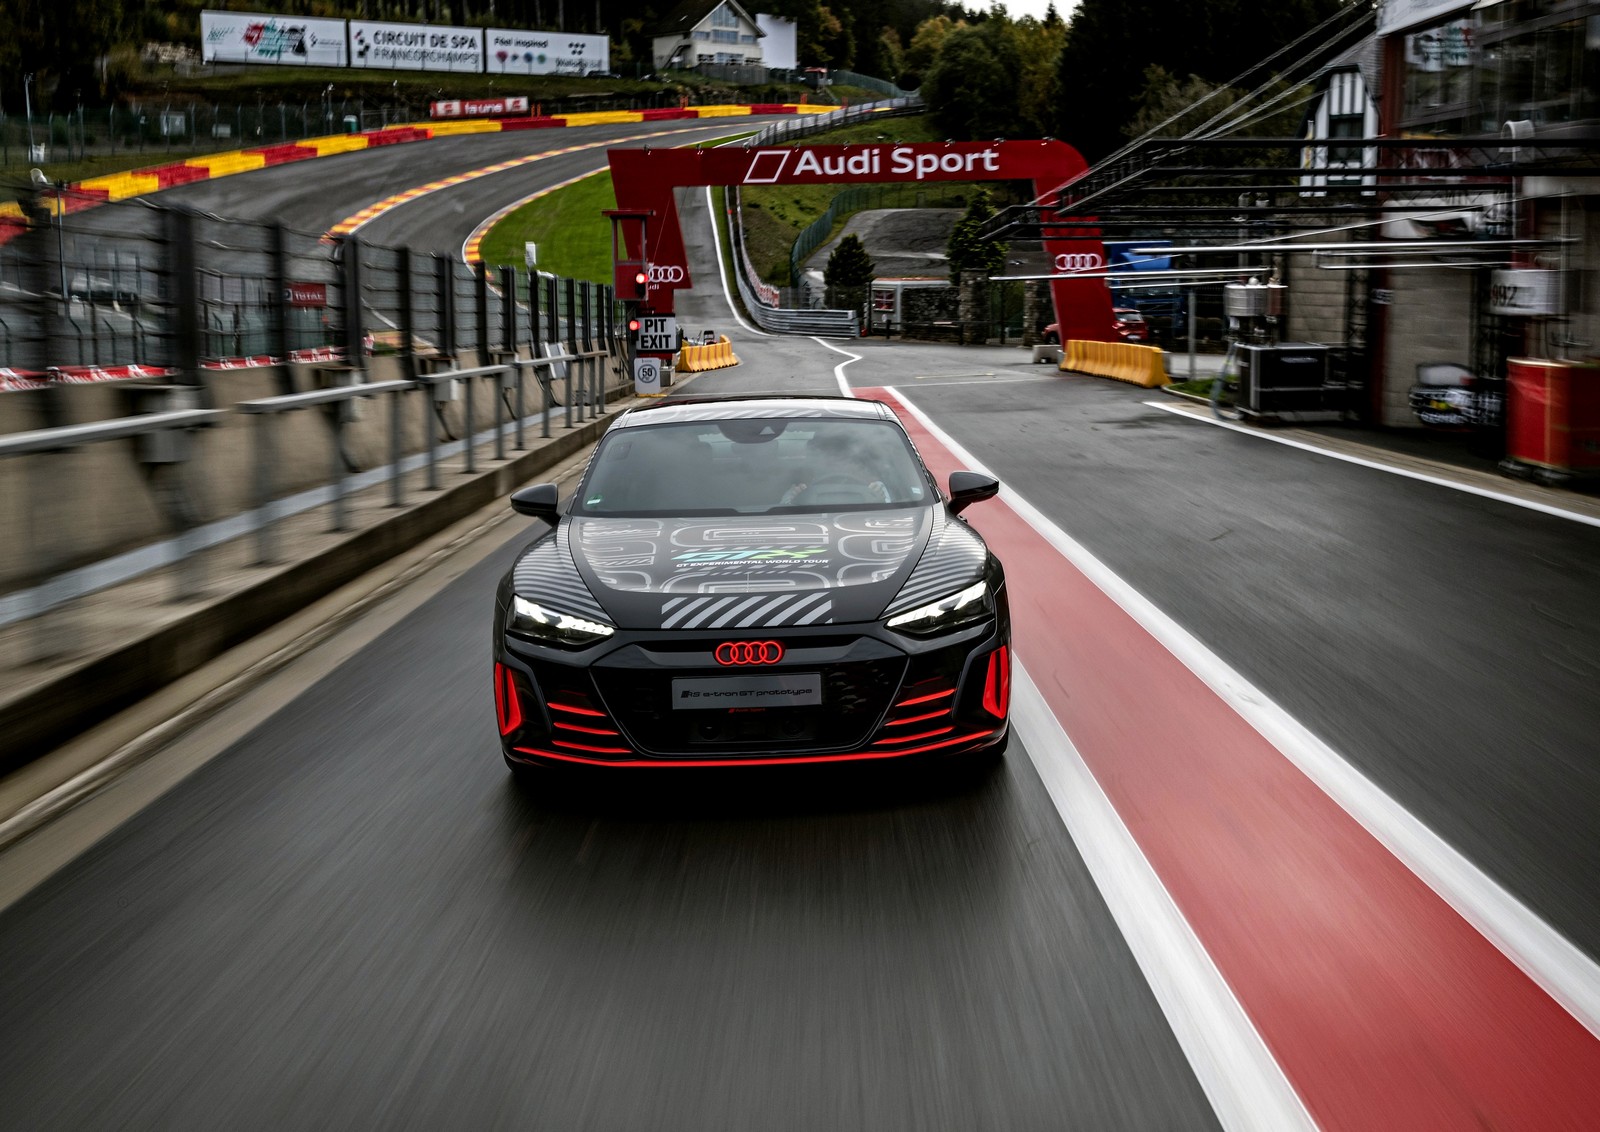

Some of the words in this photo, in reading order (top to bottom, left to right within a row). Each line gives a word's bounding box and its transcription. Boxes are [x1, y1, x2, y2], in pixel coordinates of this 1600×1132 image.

[373, 30, 427, 47] CIRCUIT
[430, 33, 449, 48] DE
[451, 34, 478, 50] SPA
[373, 45, 480, 64] FRANCORCHAMPS
[793, 149, 880, 176] Audi
[891, 147, 999, 179] Sport
[295, 291, 324, 300] TOTAL
[644, 319, 667, 333] PIT
[641, 335, 671, 349] EXIT
[642, 367, 653, 377] 50
[703, 690, 739, 698] e-tron
[756, 688, 813, 697] prototype
